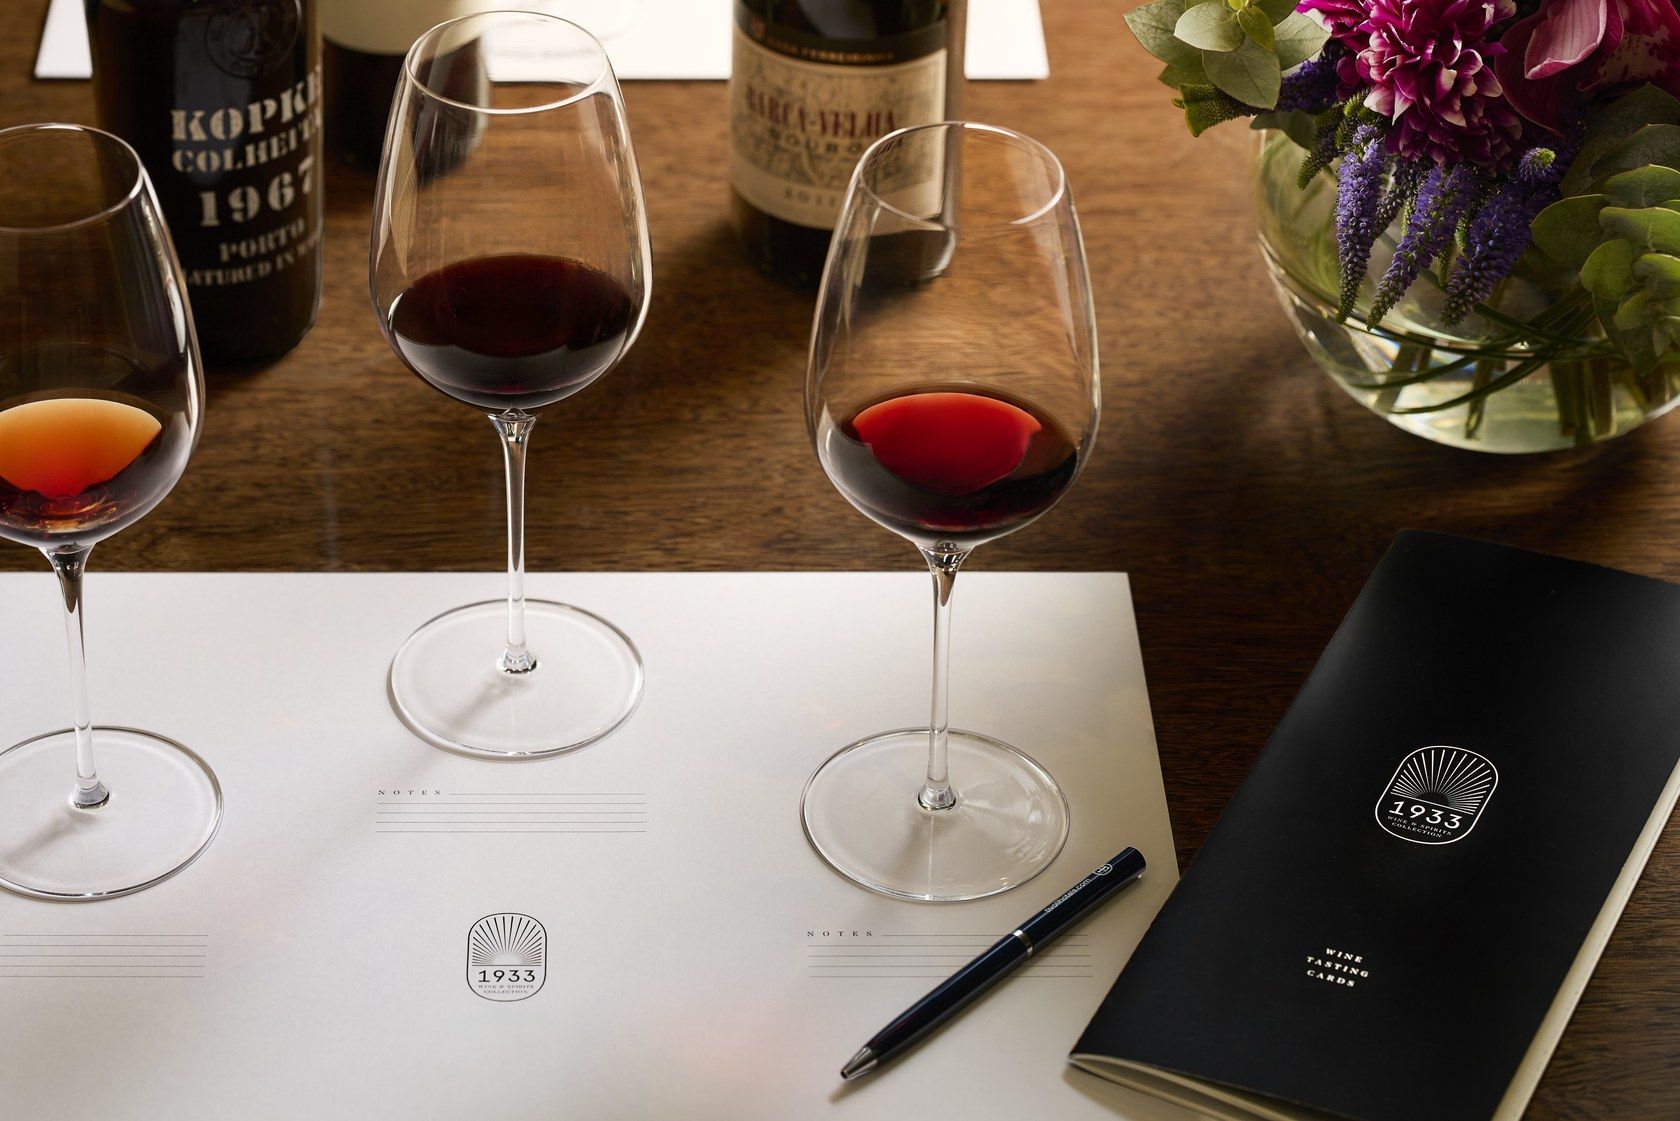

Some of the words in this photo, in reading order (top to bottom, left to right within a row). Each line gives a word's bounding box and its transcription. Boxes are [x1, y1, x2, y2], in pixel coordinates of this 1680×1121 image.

[199, 155, 314, 227] 1967
[219, 216, 305, 262] PORTO
[1388, 800, 1463, 829] 1933
[1387, 815, 1408, 824] WINE
[1420, 824, 1452, 836] SPIRITS
[1391, 822, 1442, 838] COLLECTION
[1326, 948, 1363, 963] WINE
[478, 969, 536, 983] 1933
[1306, 956, 1369, 978] TASTING
[1306, 969, 1355, 987] CARDS
